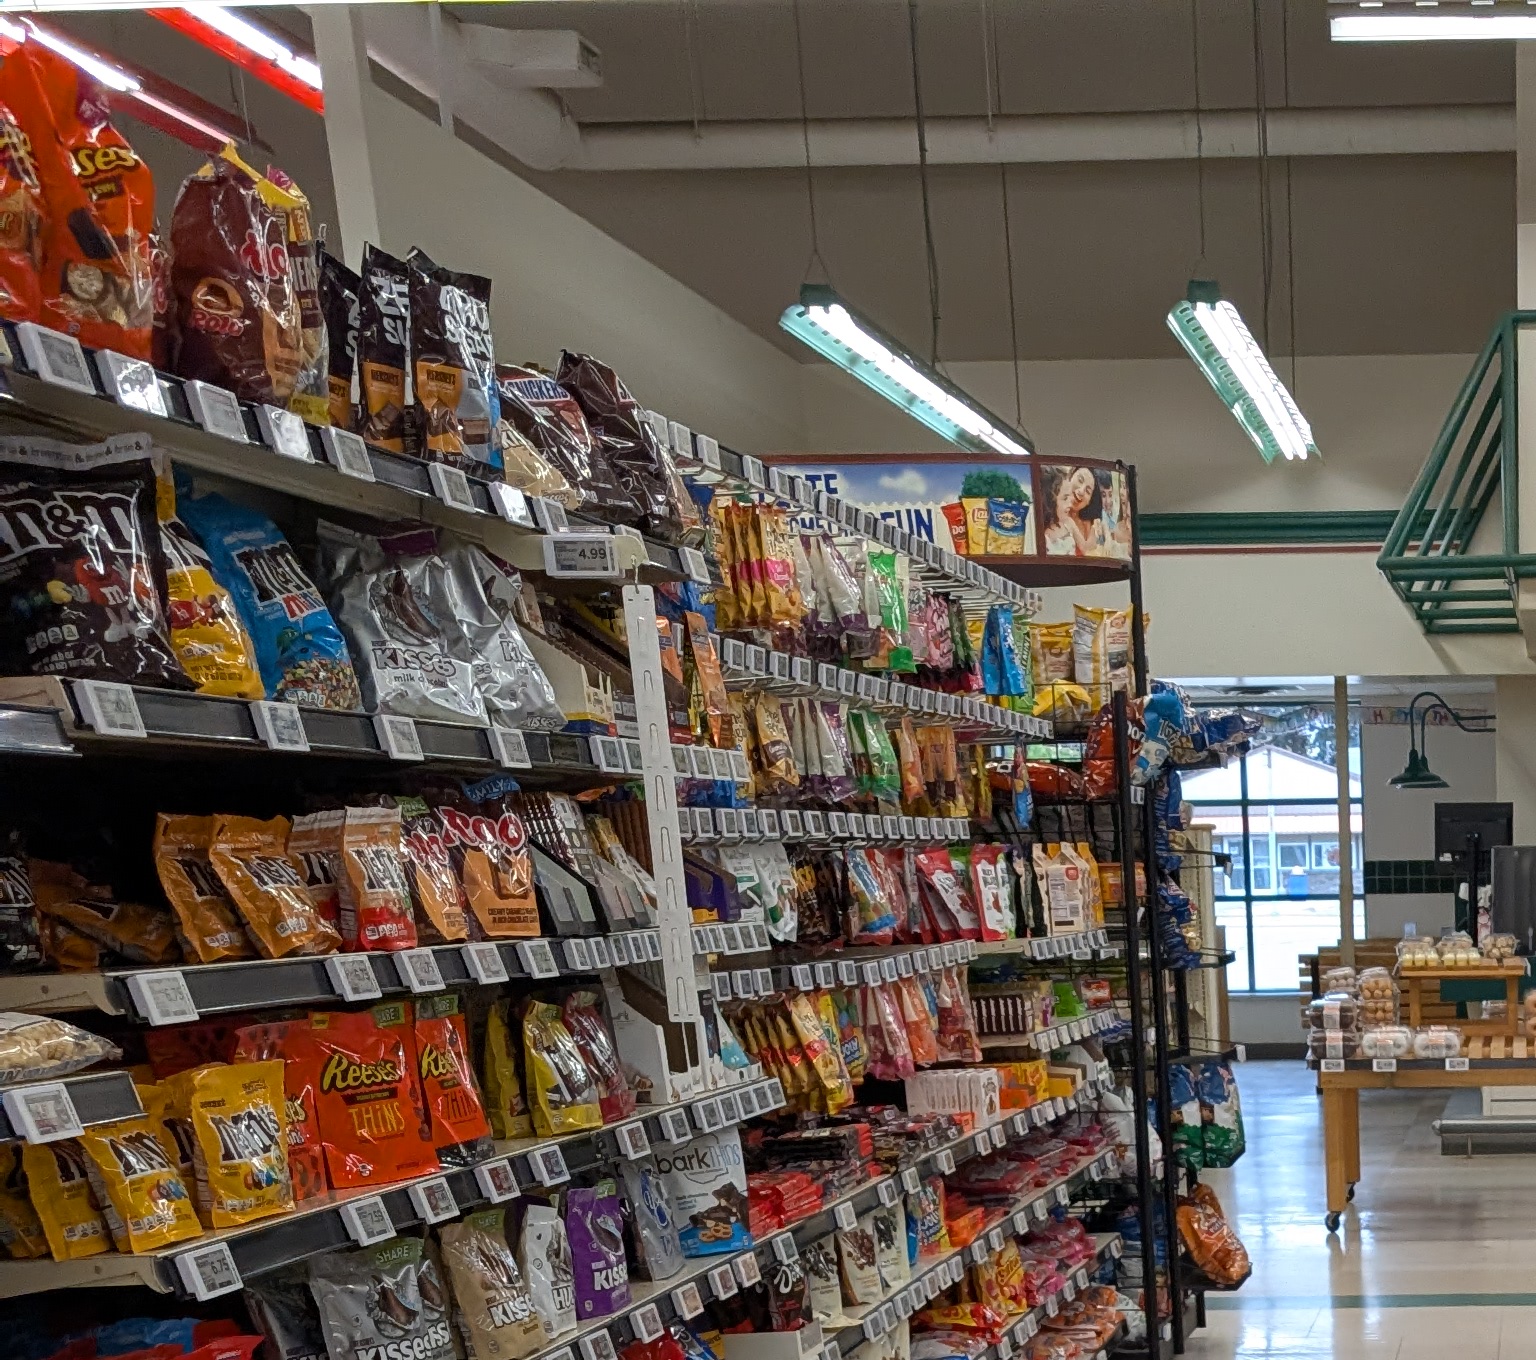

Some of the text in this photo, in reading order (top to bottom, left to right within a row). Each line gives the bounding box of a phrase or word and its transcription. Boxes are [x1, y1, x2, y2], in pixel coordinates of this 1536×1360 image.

[578, 548, 607, 561] 4.99
[373, 648, 456, 678] KISSES
[393, 673, 416, 684] milk
[323, 1053, 398, 1091] Reese's
[375, 1245, 410, 1263] SHARE
[211, 1259, 230, 1275] 6.75
